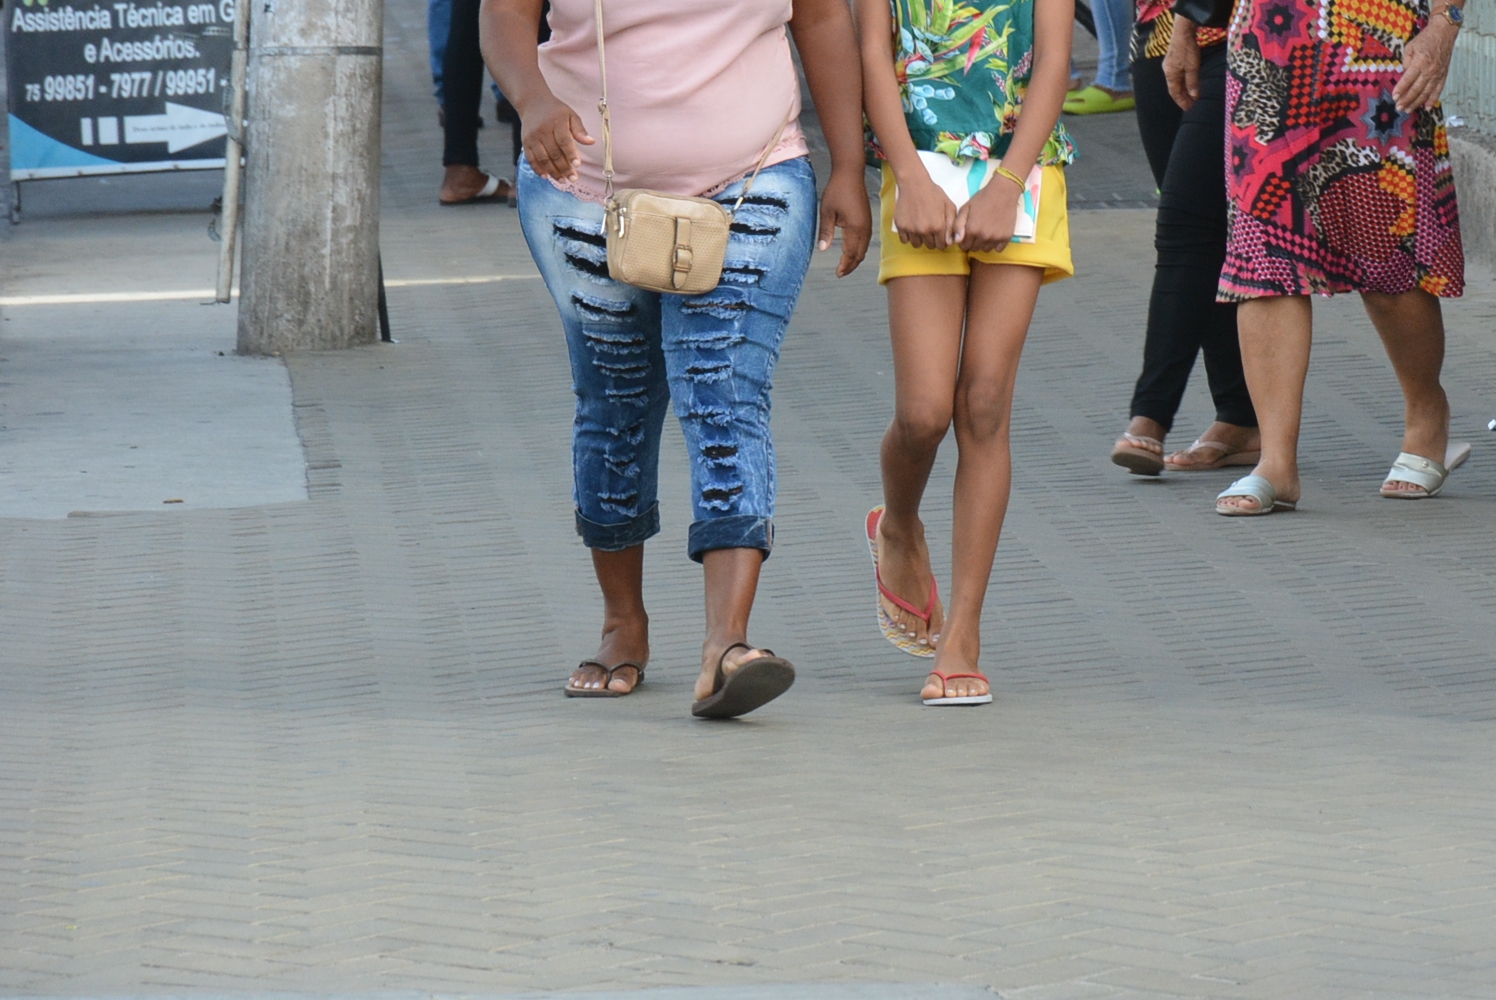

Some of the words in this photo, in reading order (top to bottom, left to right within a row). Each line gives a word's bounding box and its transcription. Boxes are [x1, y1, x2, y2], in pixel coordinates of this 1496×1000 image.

[12, 5, 112, 32] Assistência
[114, 1, 184, 28] Técnica
[188, 4, 215, 25] em
[84, 43, 96, 63] e
[100, 34, 201, 62] Acessórios.
[25, 83, 40, 101] 75
[44, 74, 94, 100] 99851
[111, 72, 151, 98] 7977
[165, 68, 215, 96] 99951
